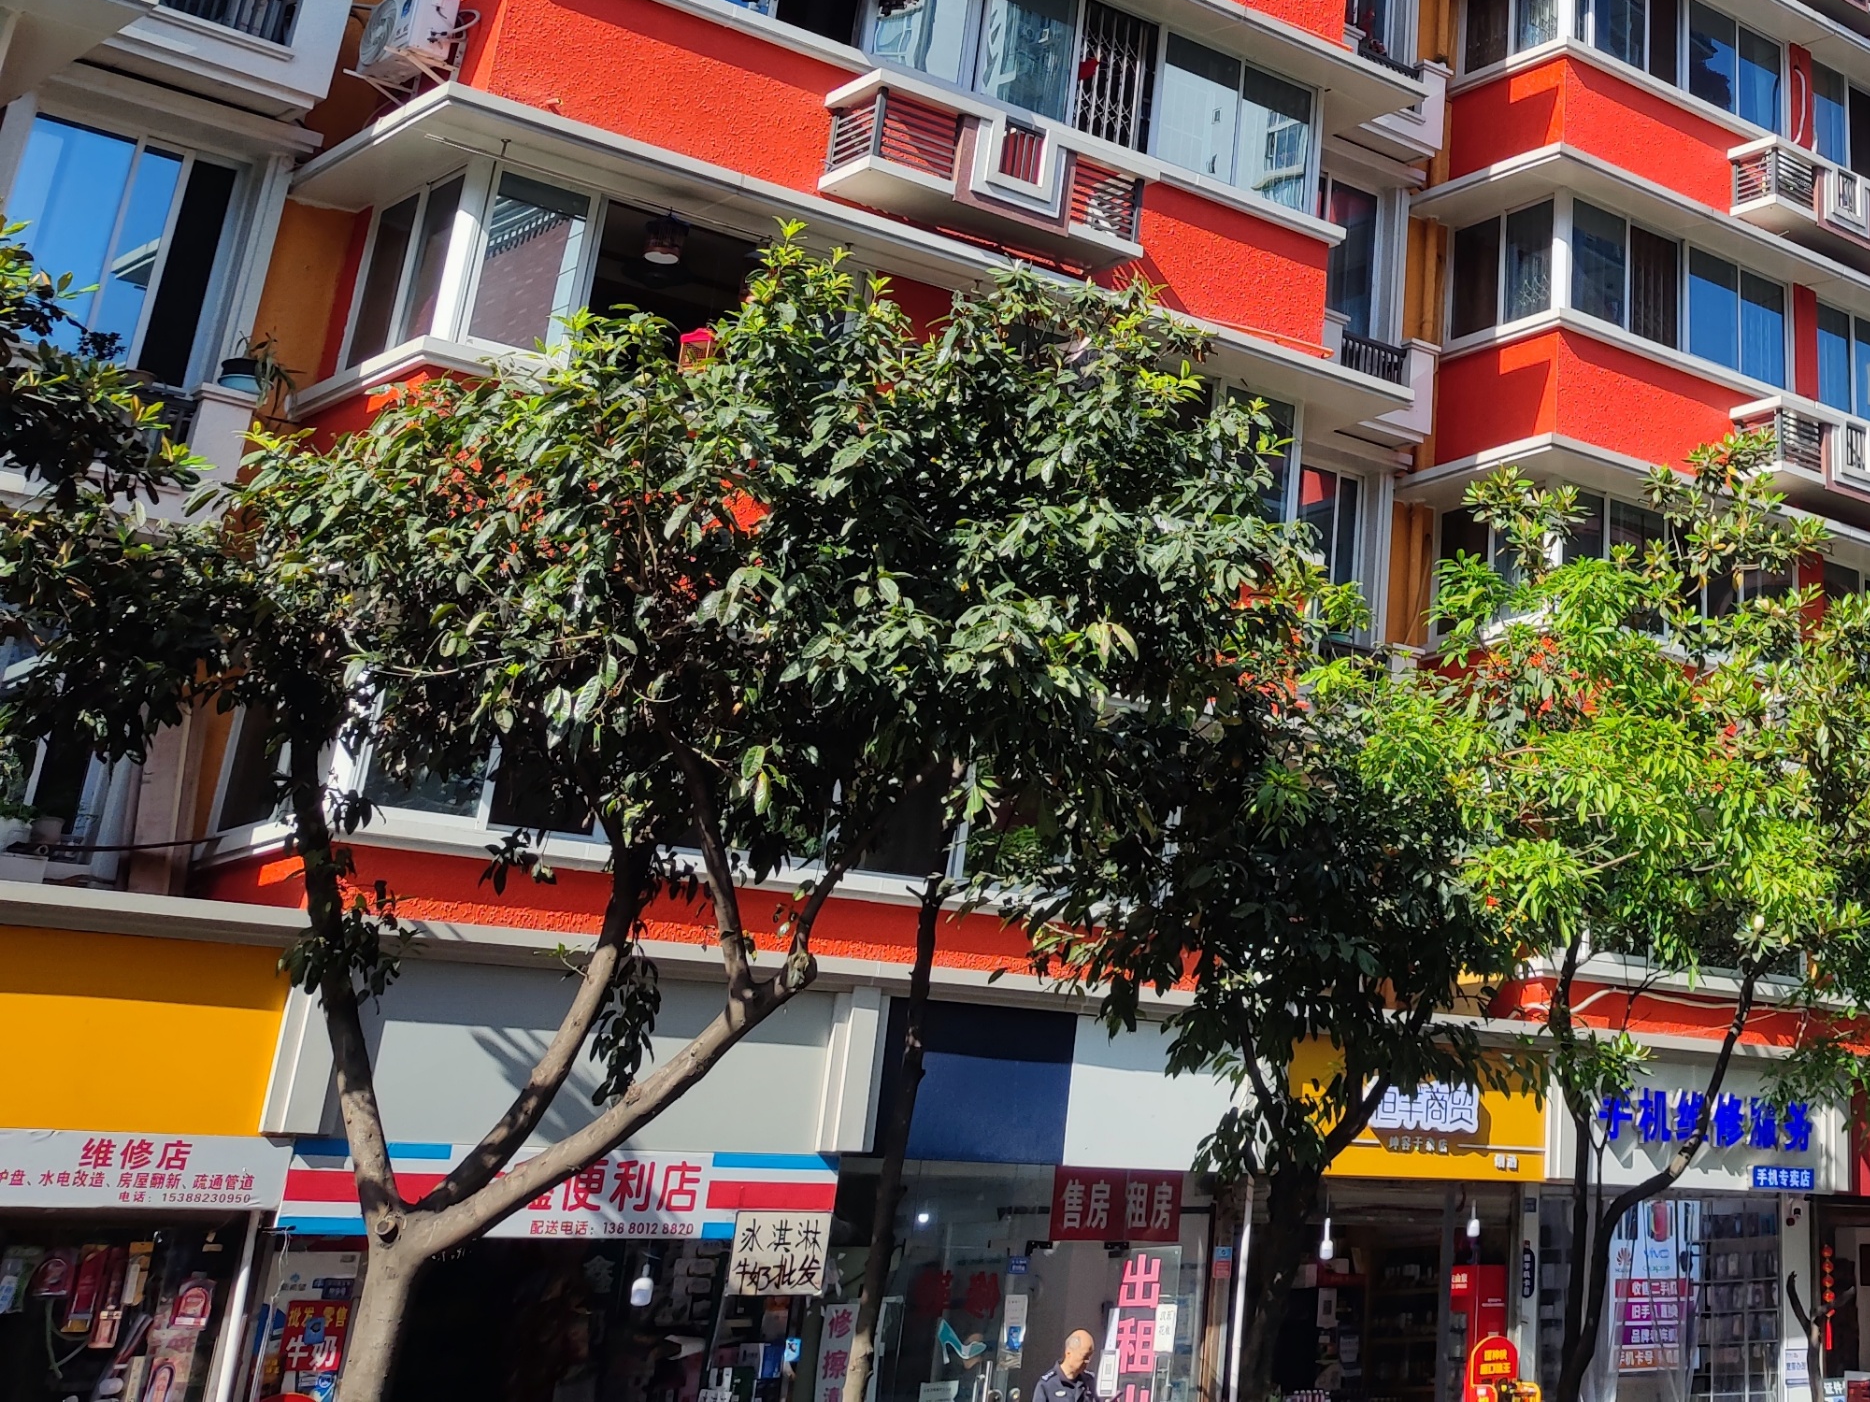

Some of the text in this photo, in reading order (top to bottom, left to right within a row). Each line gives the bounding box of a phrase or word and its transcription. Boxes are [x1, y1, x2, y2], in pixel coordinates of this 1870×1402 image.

[78, 1137, 194, 1171] 维修店
[1756, 1168, 1811, 1188] 手机专卖店
[161, 1192, 251, 1204] 15388230950
[1062, 1178, 1174, 1230] 售房 租房
[603, 1221, 624, 1235] 138
[628, 1221, 658, 1235] 8012
[661, 1222, 695, 1236] 8820
[738, 1218, 822, 1254] 冰淇淋
[732, 1253, 822, 1295] 牛奶批发
[287, 1306, 348, 1327] 批发 零售
[285, 1334, 338, 1368] 牛奶
[1823, 1380, 1846, 1395] 证件
